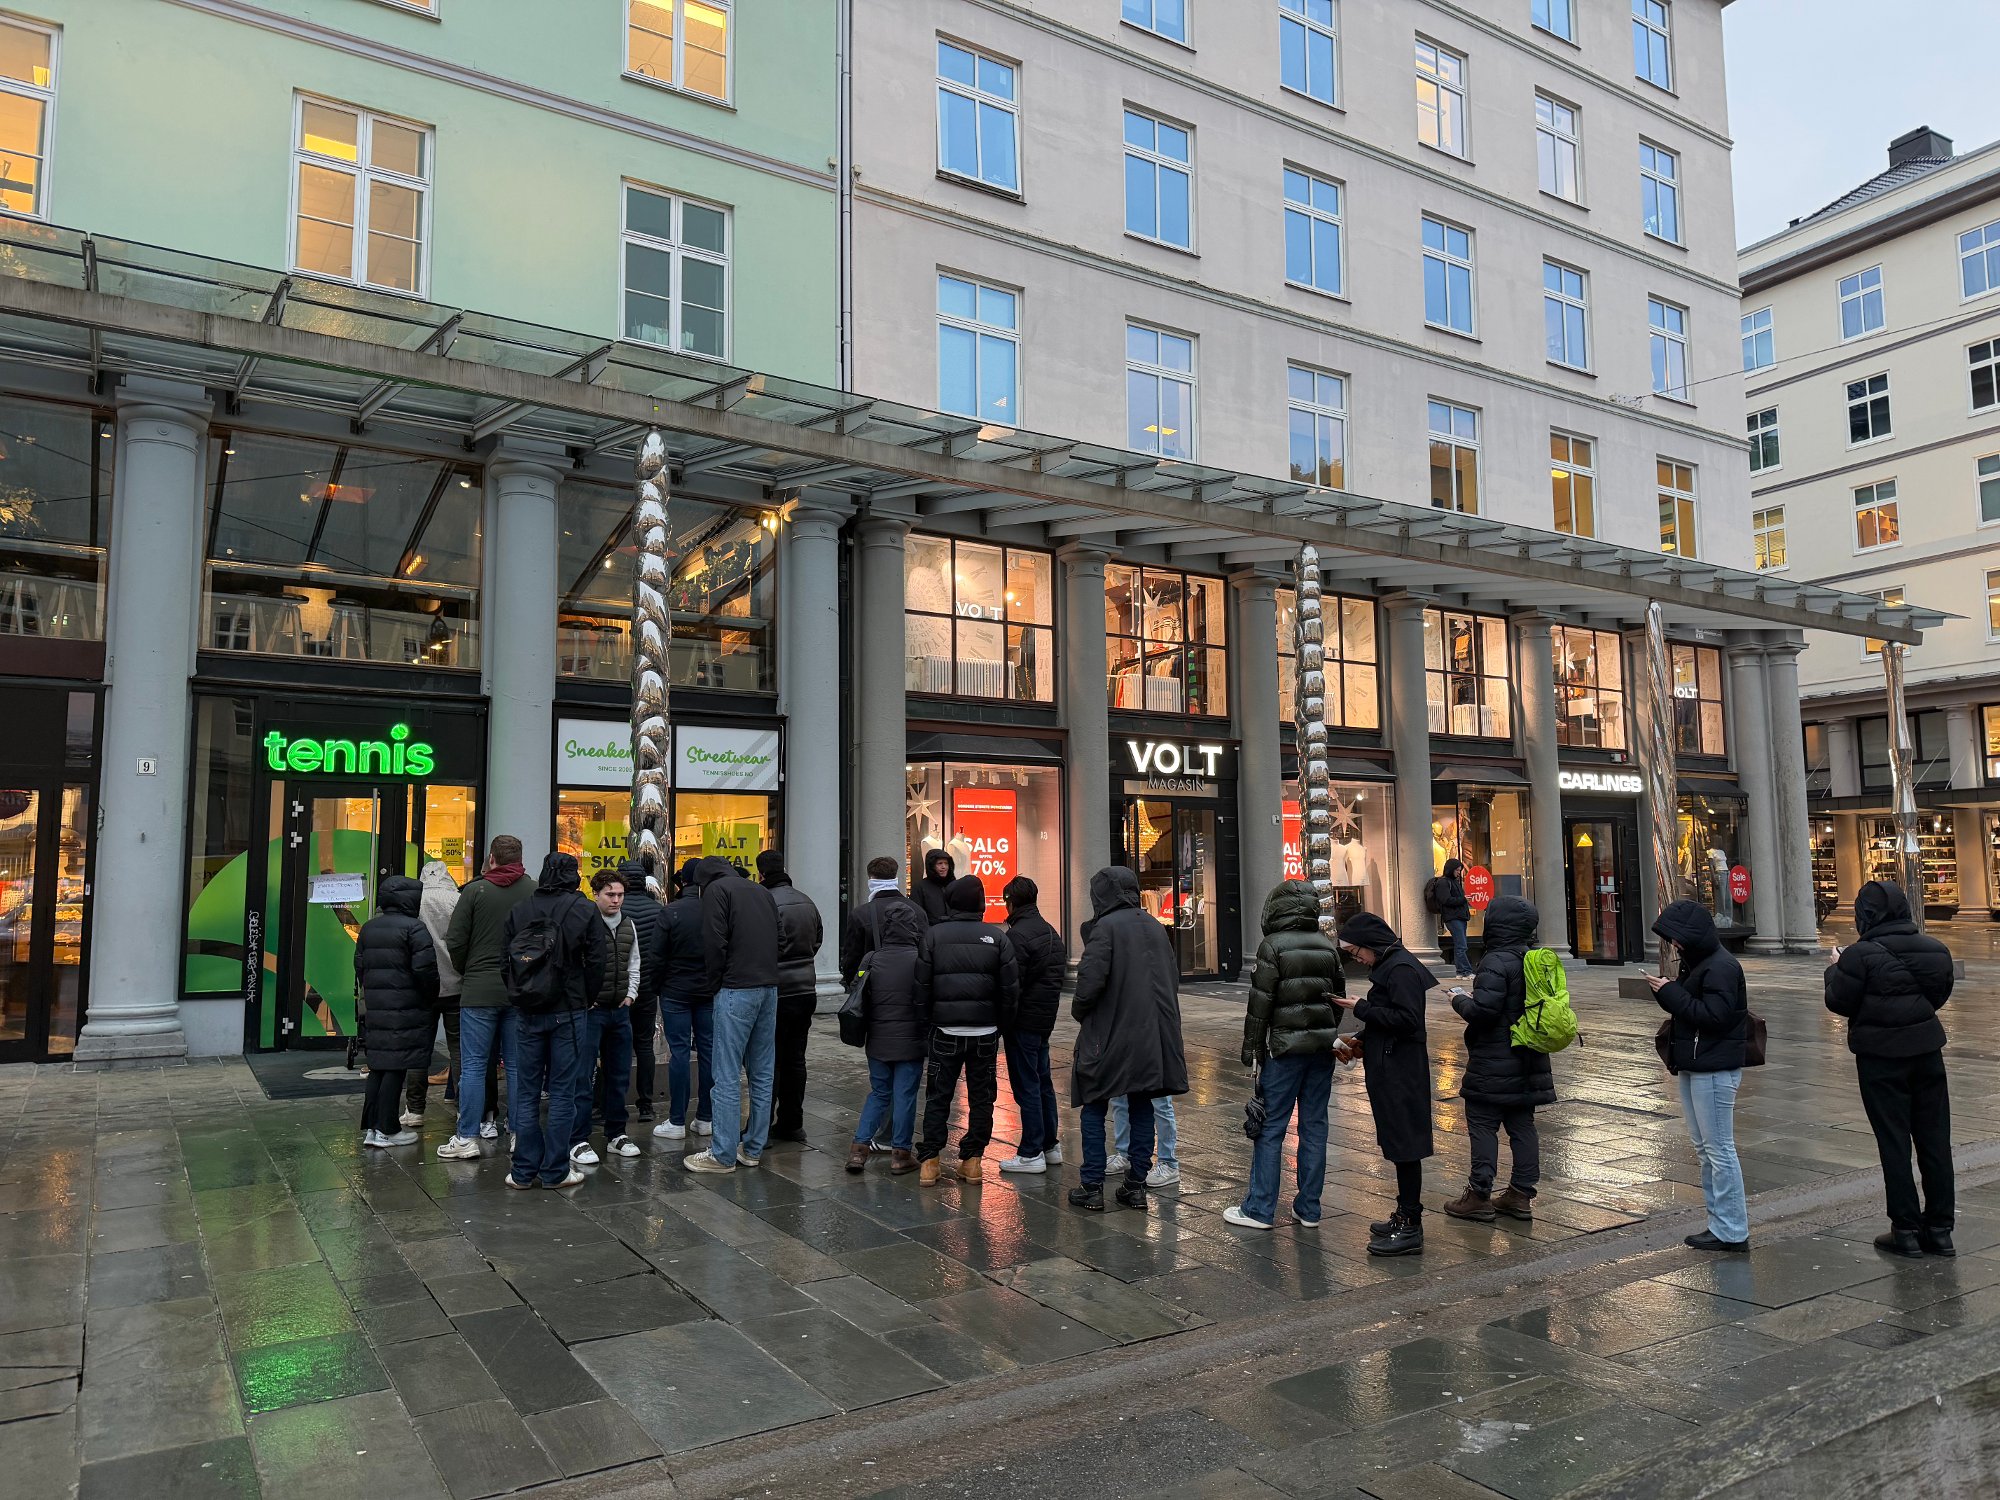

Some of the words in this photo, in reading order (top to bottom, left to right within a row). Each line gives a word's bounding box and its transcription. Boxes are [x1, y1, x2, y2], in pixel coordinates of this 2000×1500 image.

[956, 601, 1002, 620] VOLT
[264, 724, 434, 775] tennis
[686, 745, 771, 765] Streetwear
[1127, 741, 1223, 776] VOLT
[143, 761, 150, 773] 9
[1147, 778, 1205, 791] MAGASIN
[1559, 772, 1642, 792] CARLINGS
[598, 836, 628, 849] ALT
[716, 837, 748, 849] ALT
[963, 837, 1009, 853] SALG
[1283, 842, 1300, 856] AL
[590, 855, 625, 868] SKA
[727, 855, 753, 867] AL
[971, 860, 1006, 876] 70%
[1470, 874, 1488, 885] Sale
[1732, 872, 1746, 881] Sale
